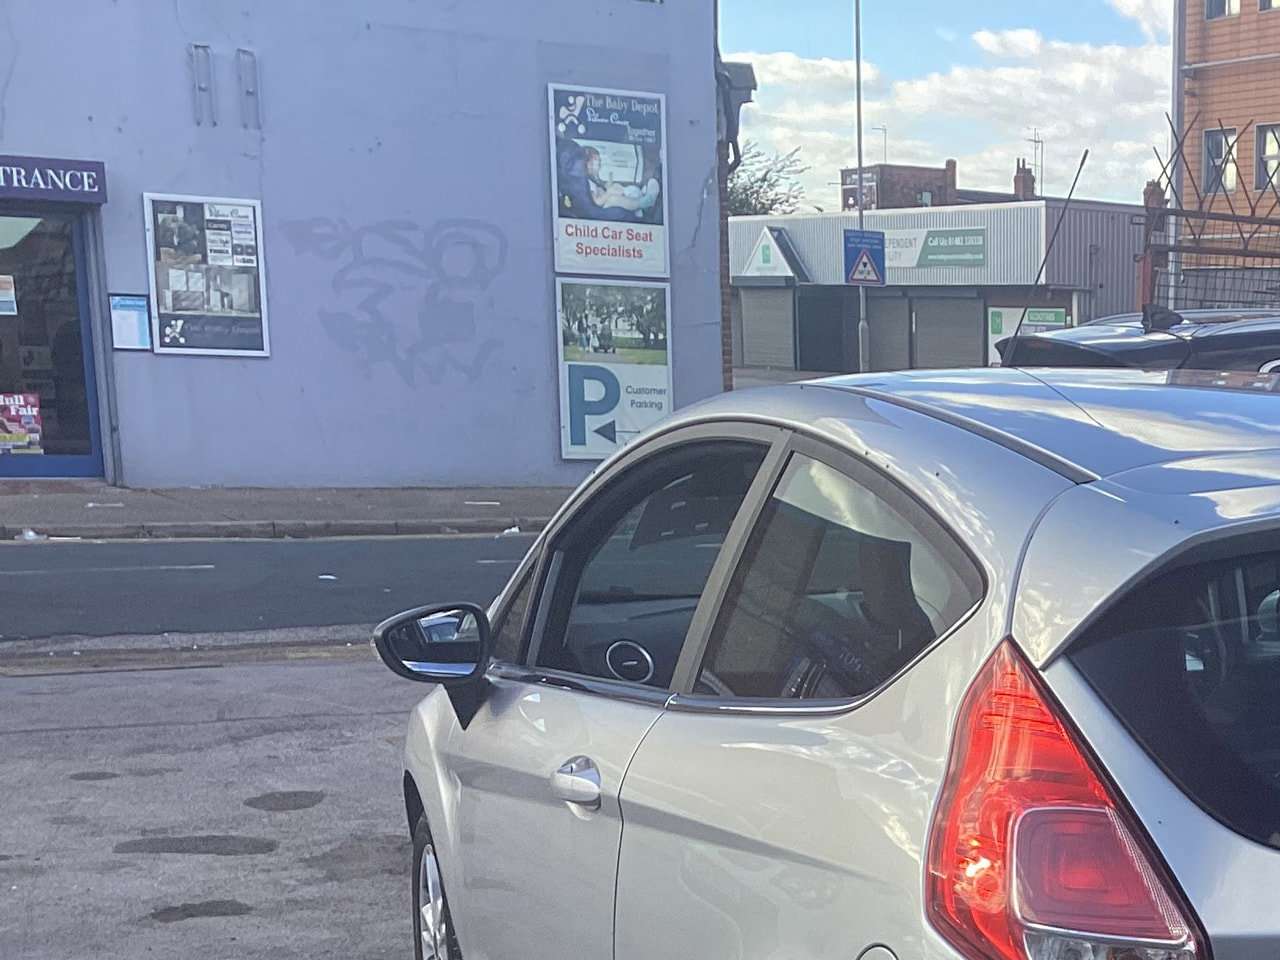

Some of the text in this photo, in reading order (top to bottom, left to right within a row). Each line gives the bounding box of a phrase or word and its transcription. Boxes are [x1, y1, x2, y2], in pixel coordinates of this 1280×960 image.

[585, 94, 603, 108] The
[631, 100, 658, 116] Depot
[565, 223, 654, 242] Child Car Seat
[576, 242, 643, 258] Specialists
[625, 385, 667, 396] Customer
[10, 405, 39, 416] Fair
[568, 364, 620, 446] P
[630, 399, 663, 411] Parking
